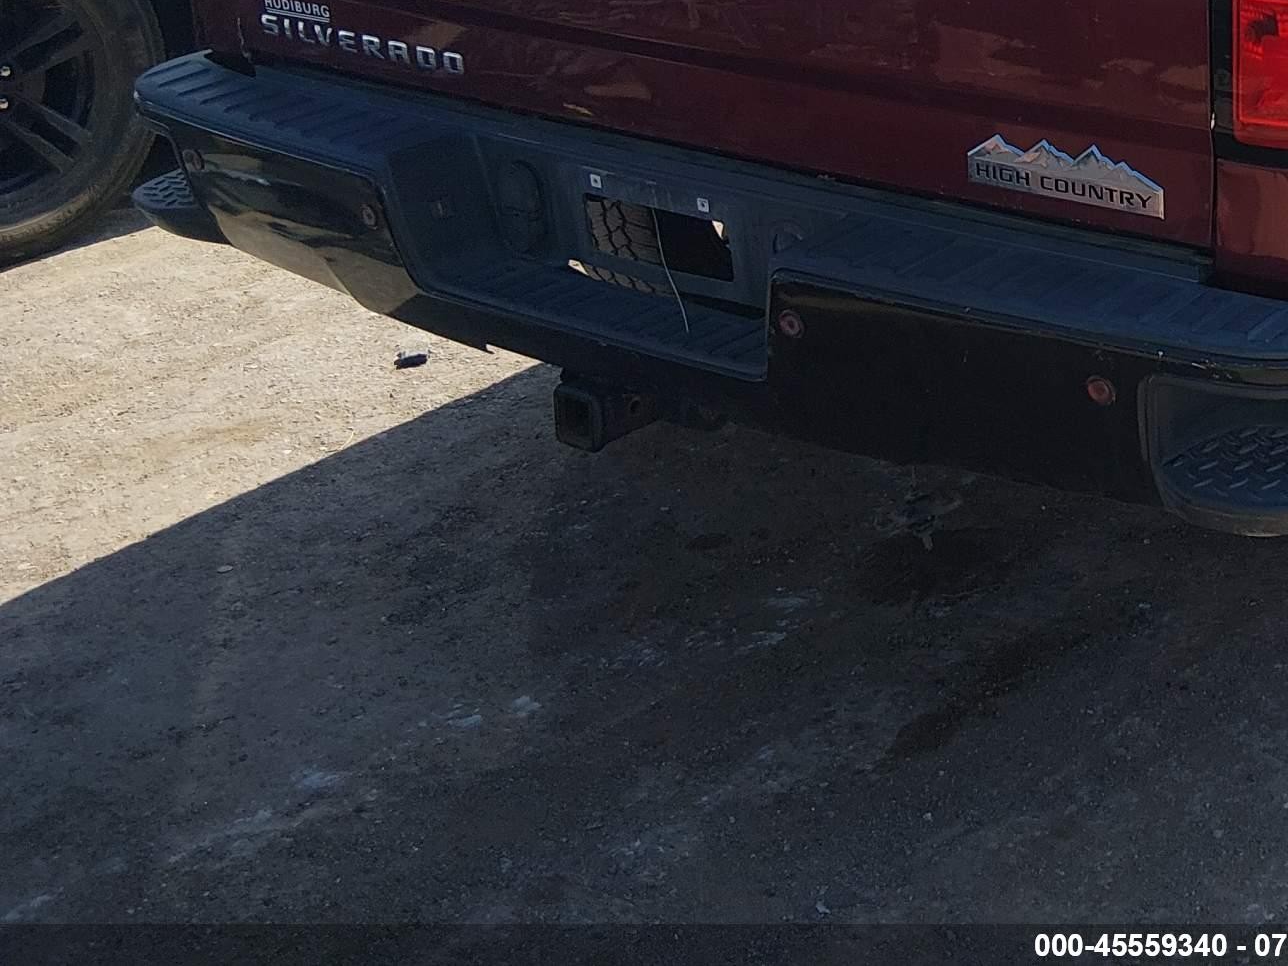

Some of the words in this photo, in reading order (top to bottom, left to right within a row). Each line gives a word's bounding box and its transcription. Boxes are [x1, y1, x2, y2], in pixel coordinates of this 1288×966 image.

[261, 14, 464, 74] SILVERADO
[975, 162, 1031, 187] HIGH
[1040, 175, 1152, 209] COUNTRY
